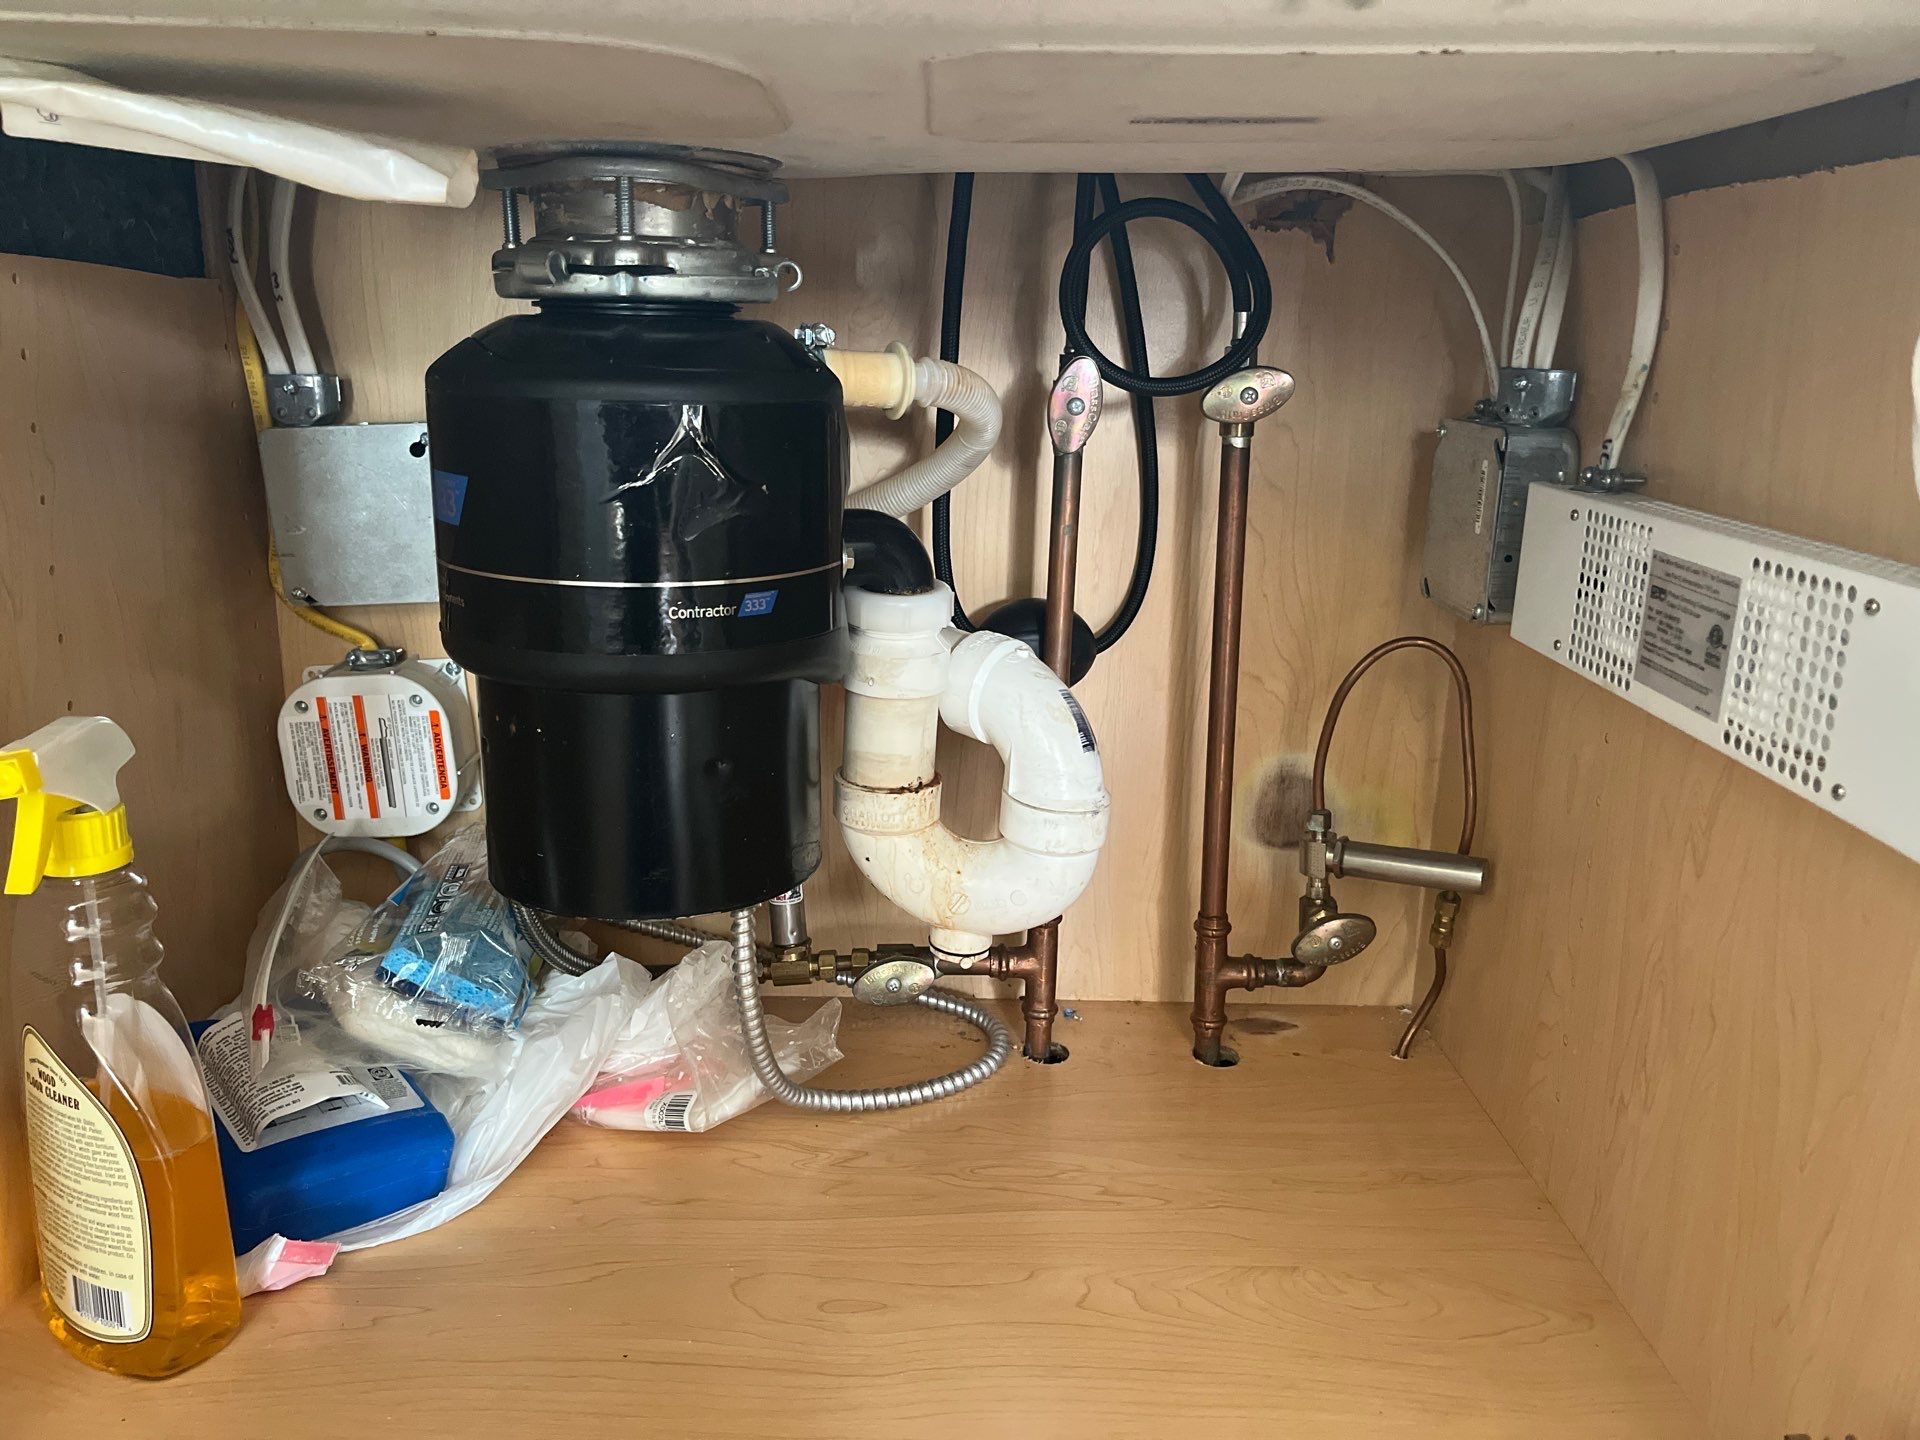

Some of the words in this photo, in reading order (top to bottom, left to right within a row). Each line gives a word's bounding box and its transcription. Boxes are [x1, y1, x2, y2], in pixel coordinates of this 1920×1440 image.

[669, 604, 737, 620] Contractor
[745, 598, 766, 612] 333
[321, 727, 340, 795] AVERTISSEMENT
[360, 743, 374, 783] WARNING
[433, 730, 448, 790] ADVERTENCIA
[26, 1072, 43, 1093] FLOOR
[45, 1086, 80, 1110] CLEANER
[37, 1068, 56, 1088] WOOD
